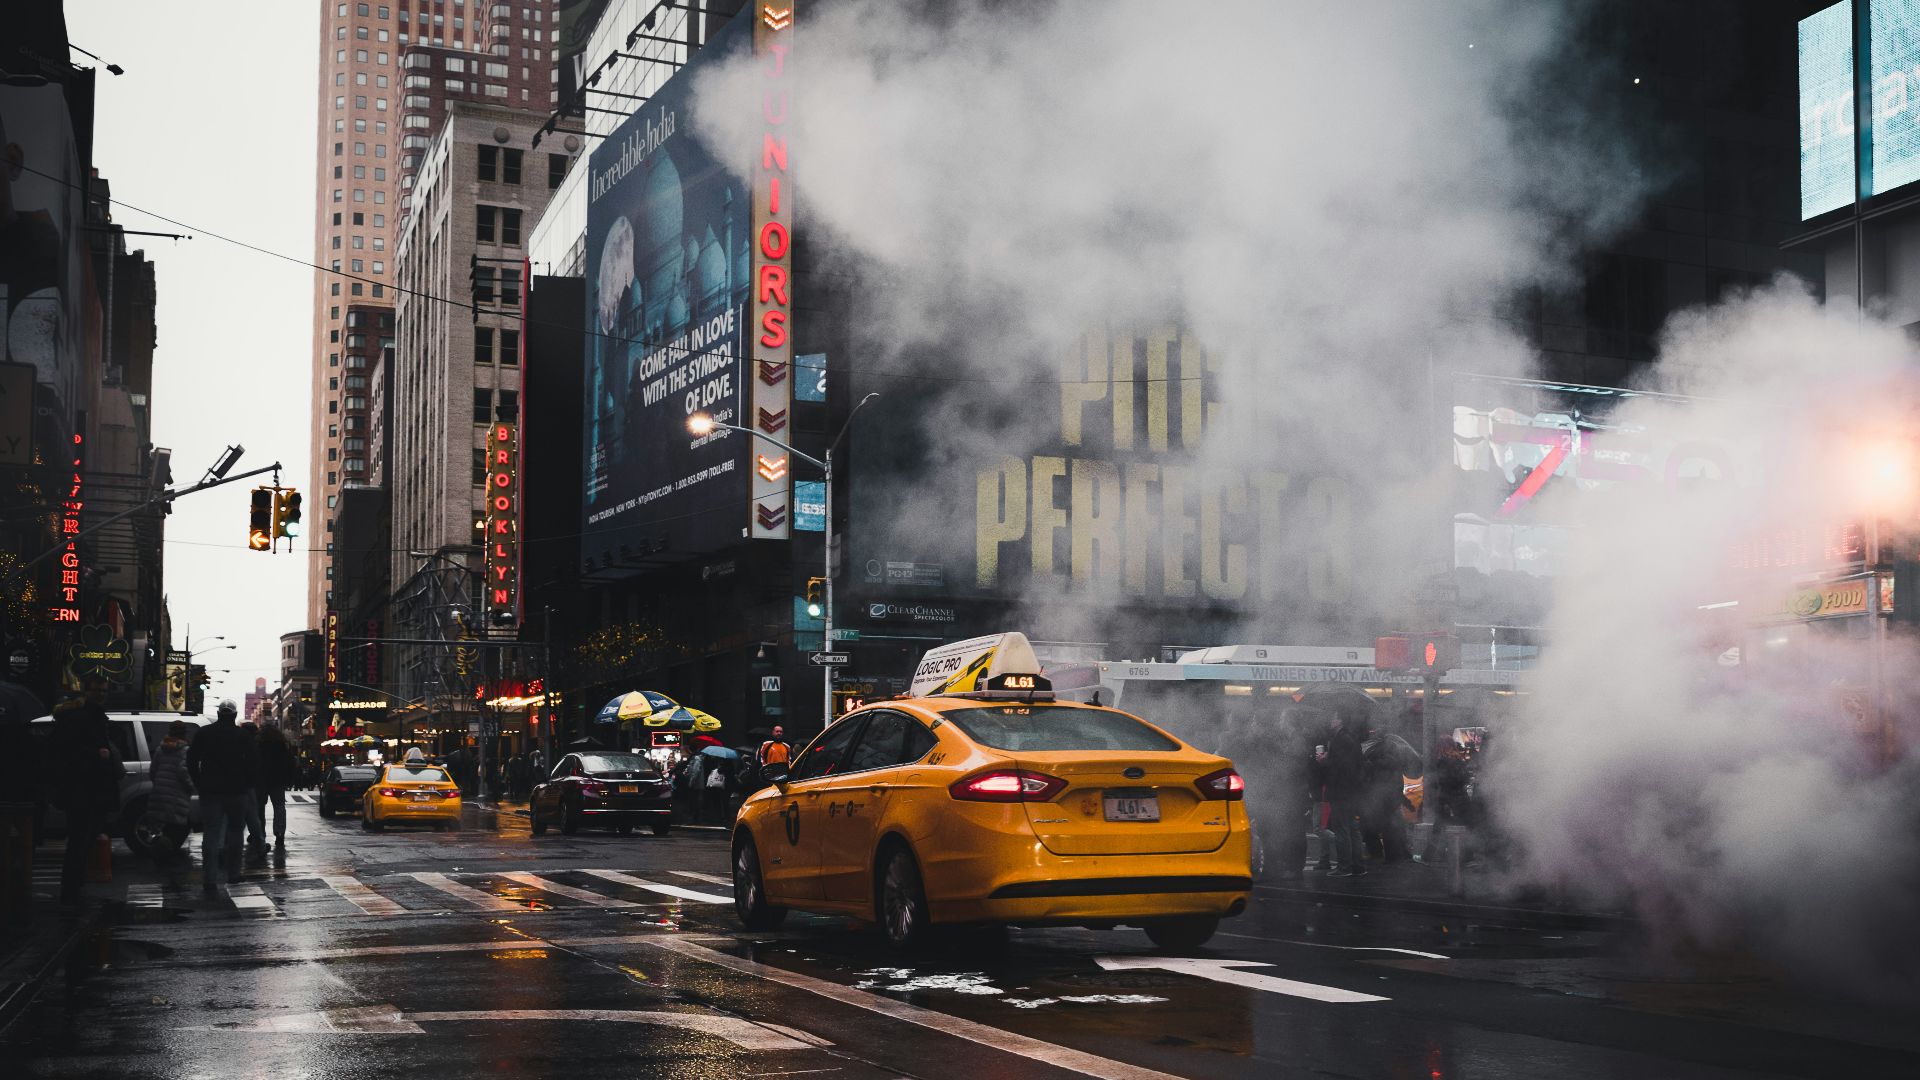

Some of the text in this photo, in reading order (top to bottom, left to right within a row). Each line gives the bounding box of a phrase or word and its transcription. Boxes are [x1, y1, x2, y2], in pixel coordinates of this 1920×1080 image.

[592, 129, 646, 203] Incredible
[639, 308, 734, 381] COME FALL IN LOVE
[643, 341, 734, 407] WITH THE SYMBOL
[685, 373, 733, 415] OF LOVE.
[495, 426, 510, 604] BROOKLYN
[976, 455, 1288, 601] PERFECT
[1824, 588, 1863, 608] FOOD
[916, 656, 962, 677] LOGIC PRO
[1003, 676, 1035, 688] 4L61
[1129, 667, 1150, 676] 6765
[1251, 667, 1308, 680] WINNER
[1310, 668, 1317, 680] 6
[1321, 668, 1357, 681] TONY
